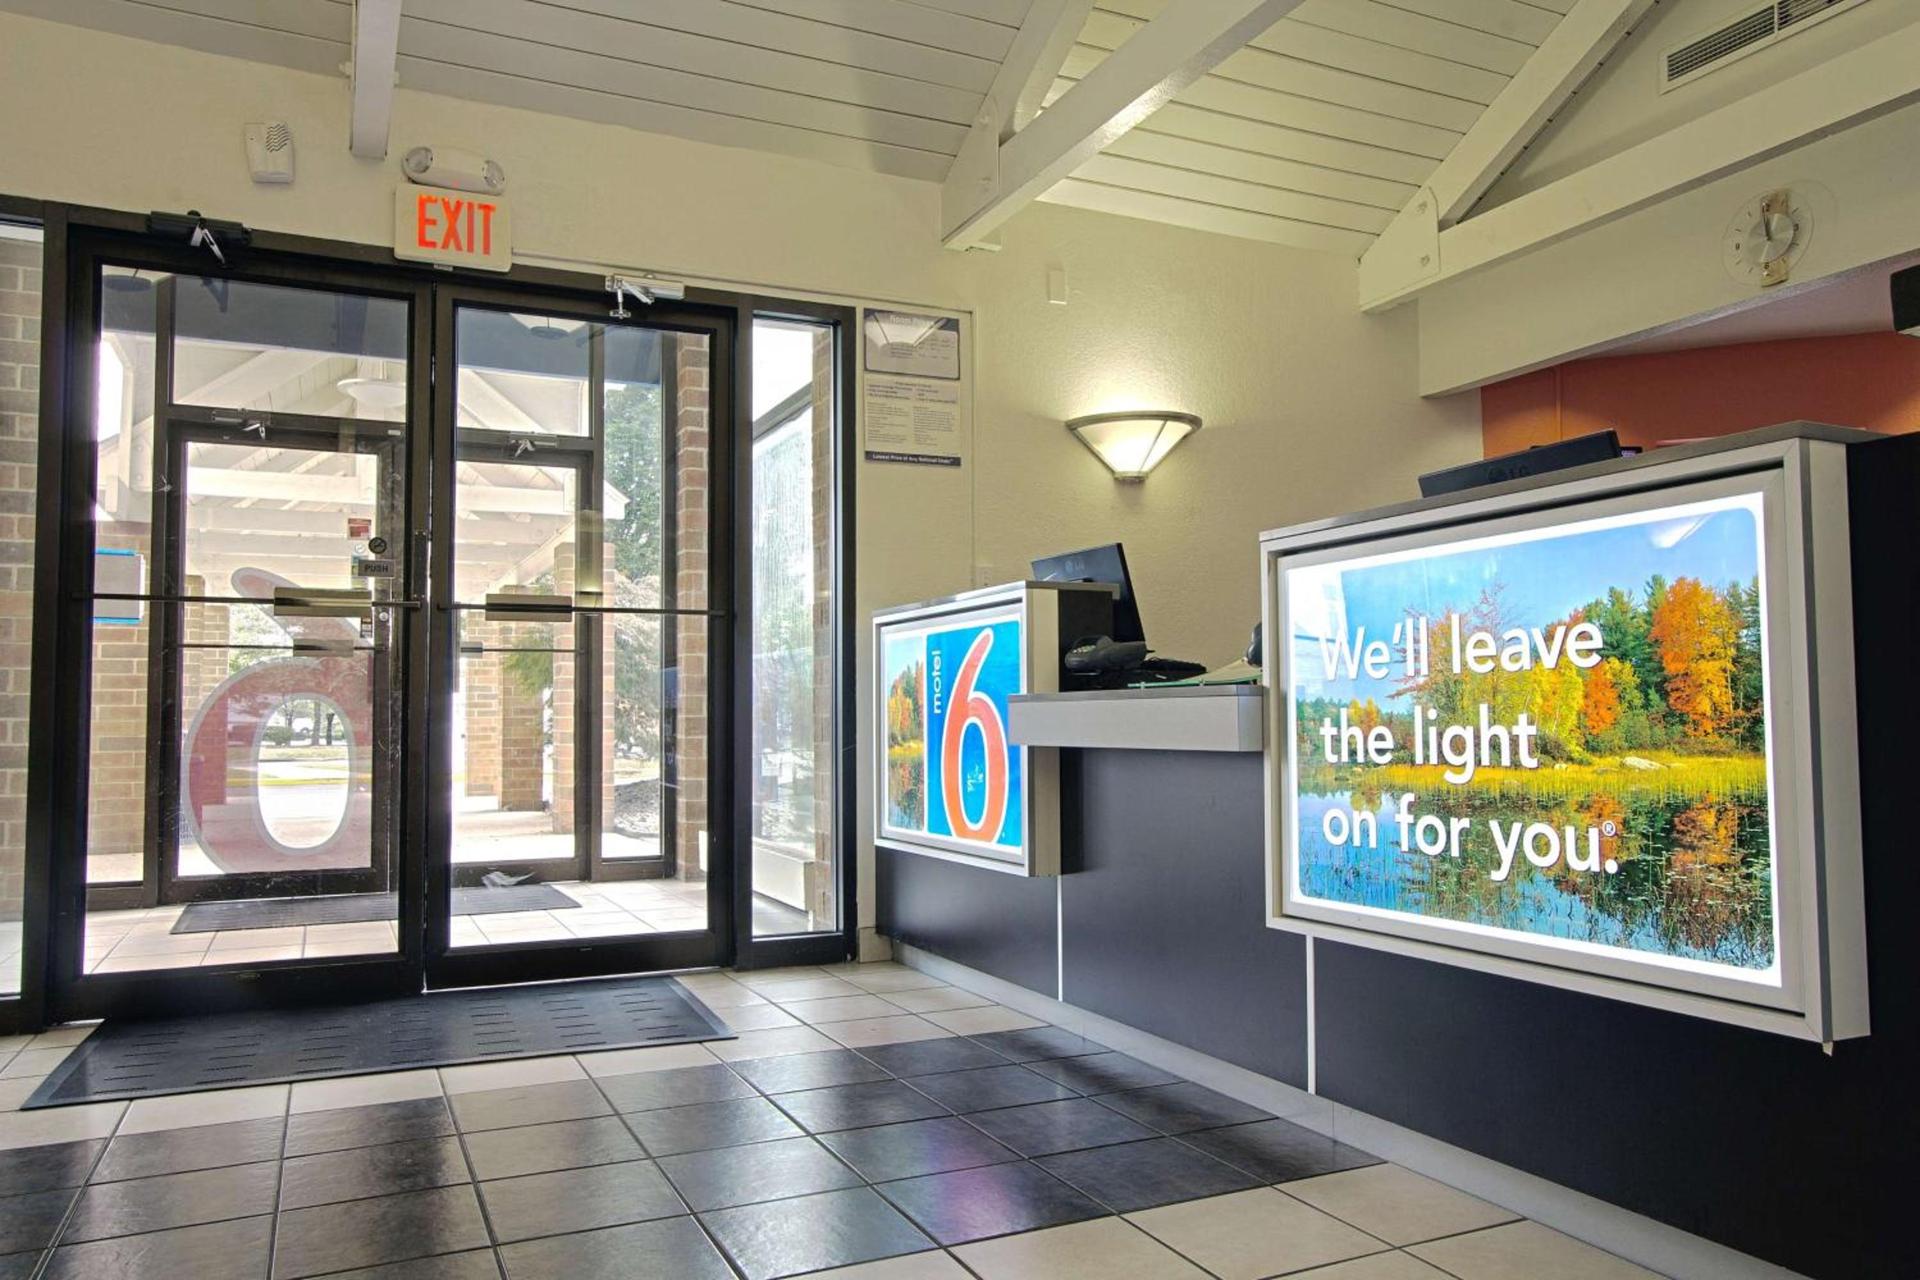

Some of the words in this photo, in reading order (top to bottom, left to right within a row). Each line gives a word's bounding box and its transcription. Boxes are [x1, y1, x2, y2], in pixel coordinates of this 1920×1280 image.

[417, 194, 496, 256] EXIT
[364, 564, 389, 574] PUSH
[1318, 616, 1429, 681] We'll
[1450, 613, 1604, 675] leave
[931, 650, 942, 714] motel
[941, 627, 1009, 843] 6
[1319, 707, 1395, 765] the
[1413, 703, 1539, 785] light
[1322, 805, 1378, 849] on
[1394, 792, 1470, 858] for
